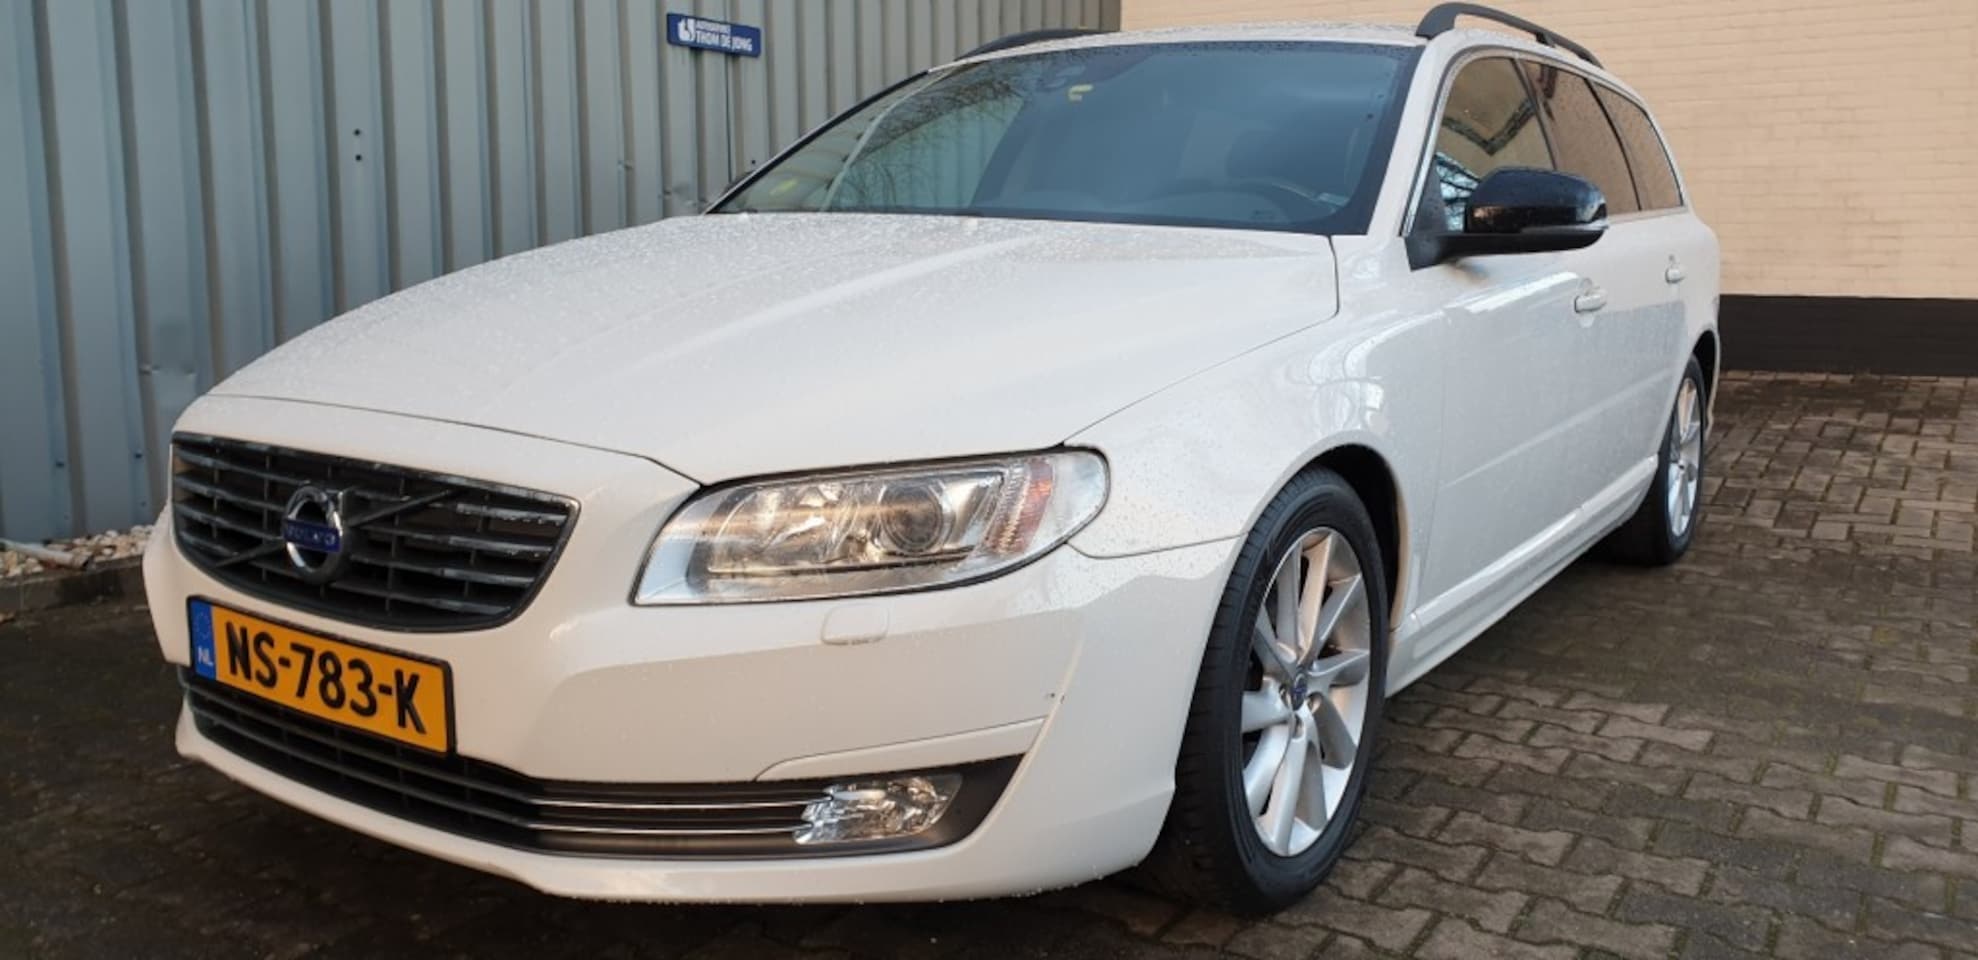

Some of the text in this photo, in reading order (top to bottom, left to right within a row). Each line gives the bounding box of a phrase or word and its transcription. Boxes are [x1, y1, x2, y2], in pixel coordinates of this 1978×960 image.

[286, 525, 336, 546] VOLVO
[198, 647, 213, 666] NL
[226, 621, 427, 735] NS-783-K
